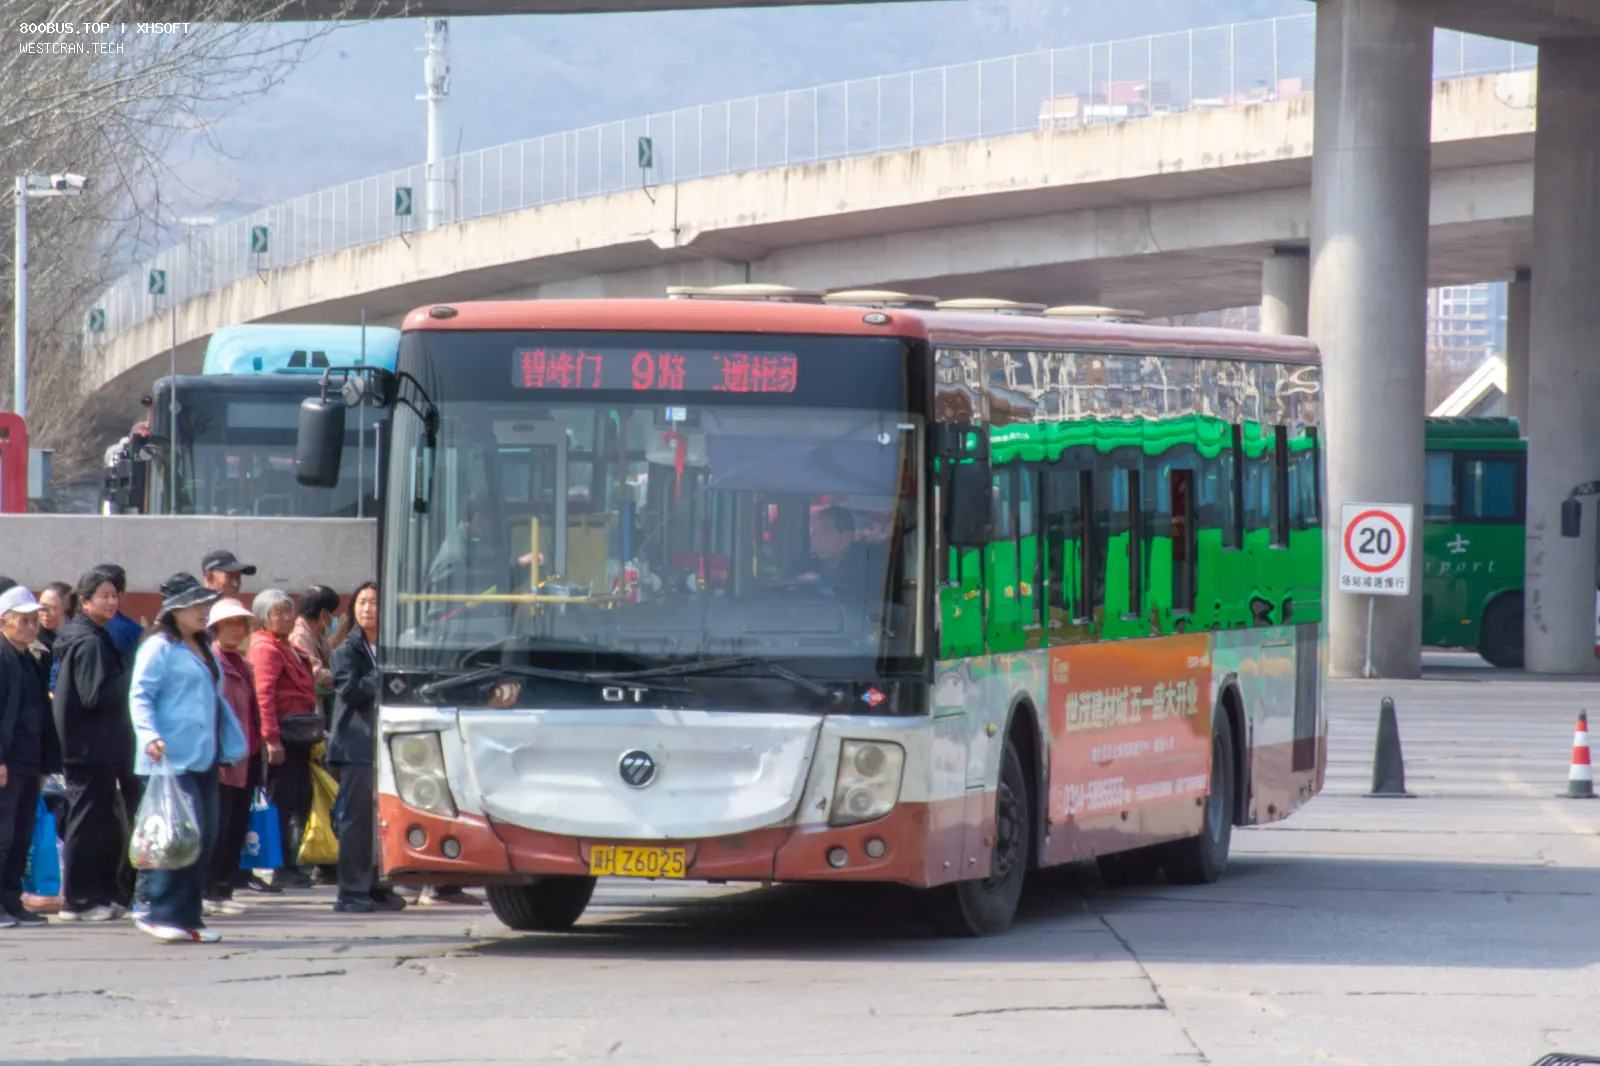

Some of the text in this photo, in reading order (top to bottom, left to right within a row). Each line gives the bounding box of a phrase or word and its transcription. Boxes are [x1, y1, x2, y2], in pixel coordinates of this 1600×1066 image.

[520, 349, 603, 389] 碧峰门
[1358, 527, 1392, 555] 20
